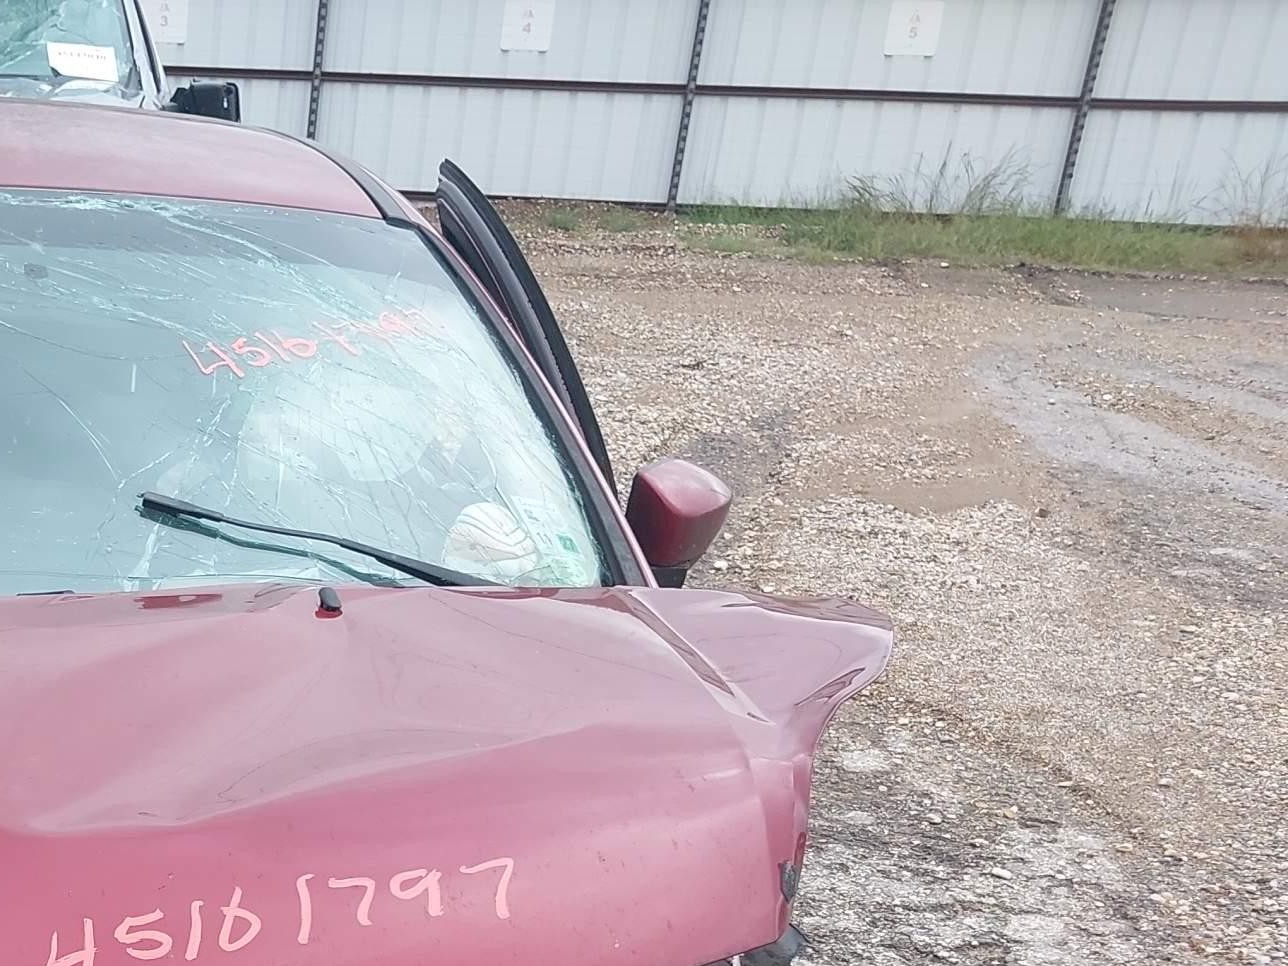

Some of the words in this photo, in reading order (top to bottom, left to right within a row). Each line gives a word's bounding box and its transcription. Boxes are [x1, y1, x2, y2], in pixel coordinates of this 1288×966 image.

[159, 15, 169, 27] 3
[521, 21, 532, 34] 4
[907, 26, 919, 39] 5
